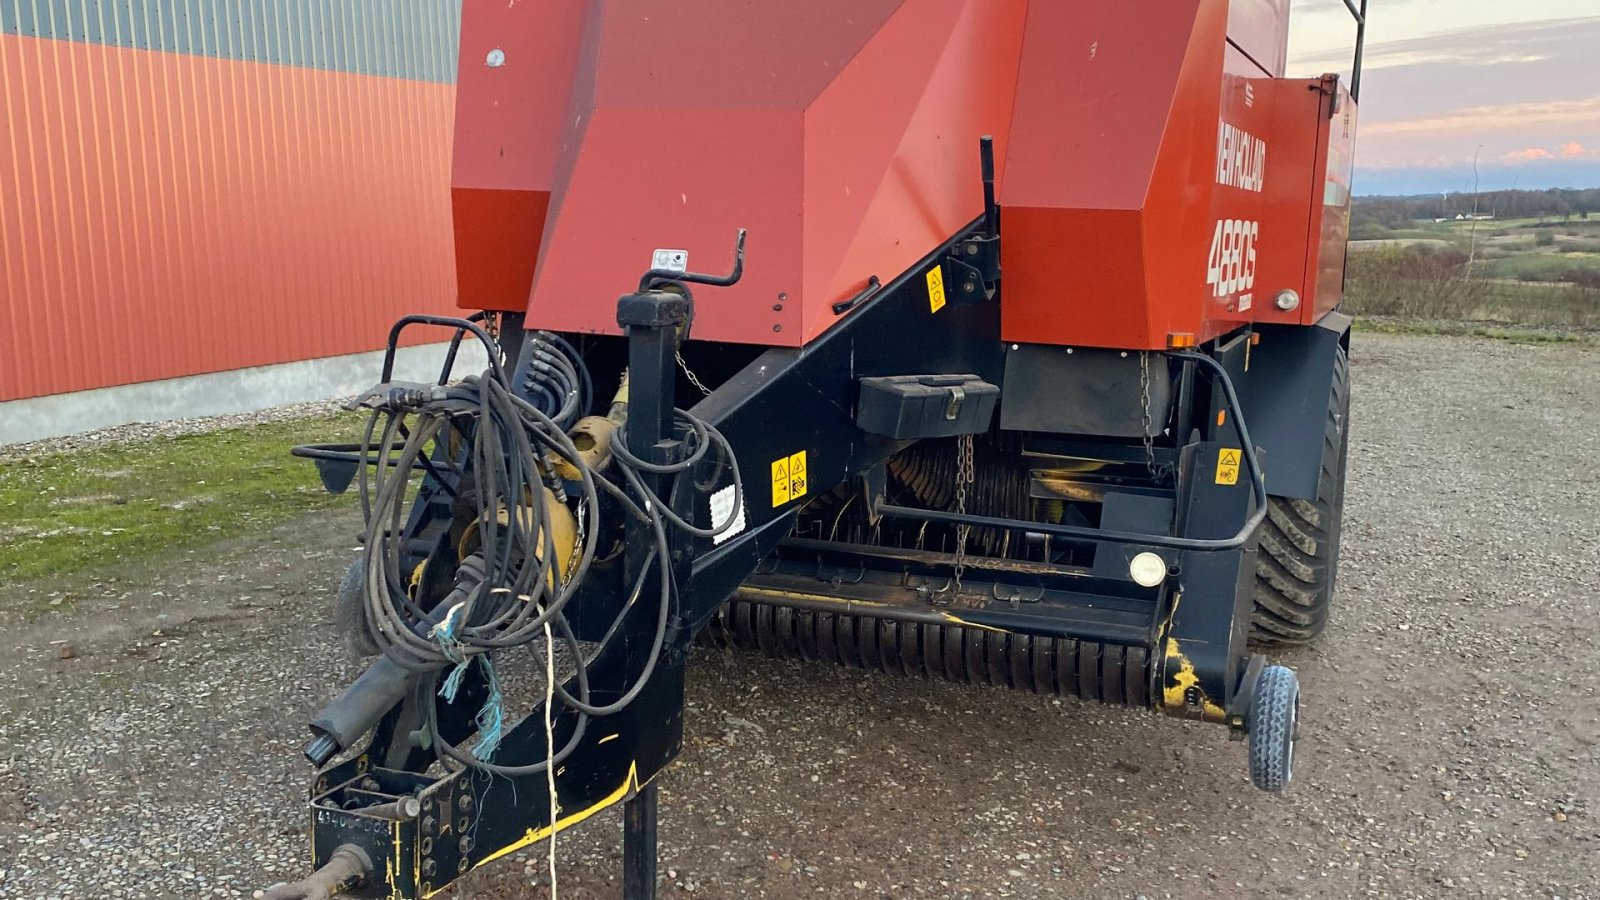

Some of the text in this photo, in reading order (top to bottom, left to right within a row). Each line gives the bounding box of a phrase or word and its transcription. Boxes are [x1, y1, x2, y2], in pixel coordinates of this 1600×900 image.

[1216, 121, 1266, 192] NEW HOLLAND
[1207, 219, 1258, 297] 4880S
